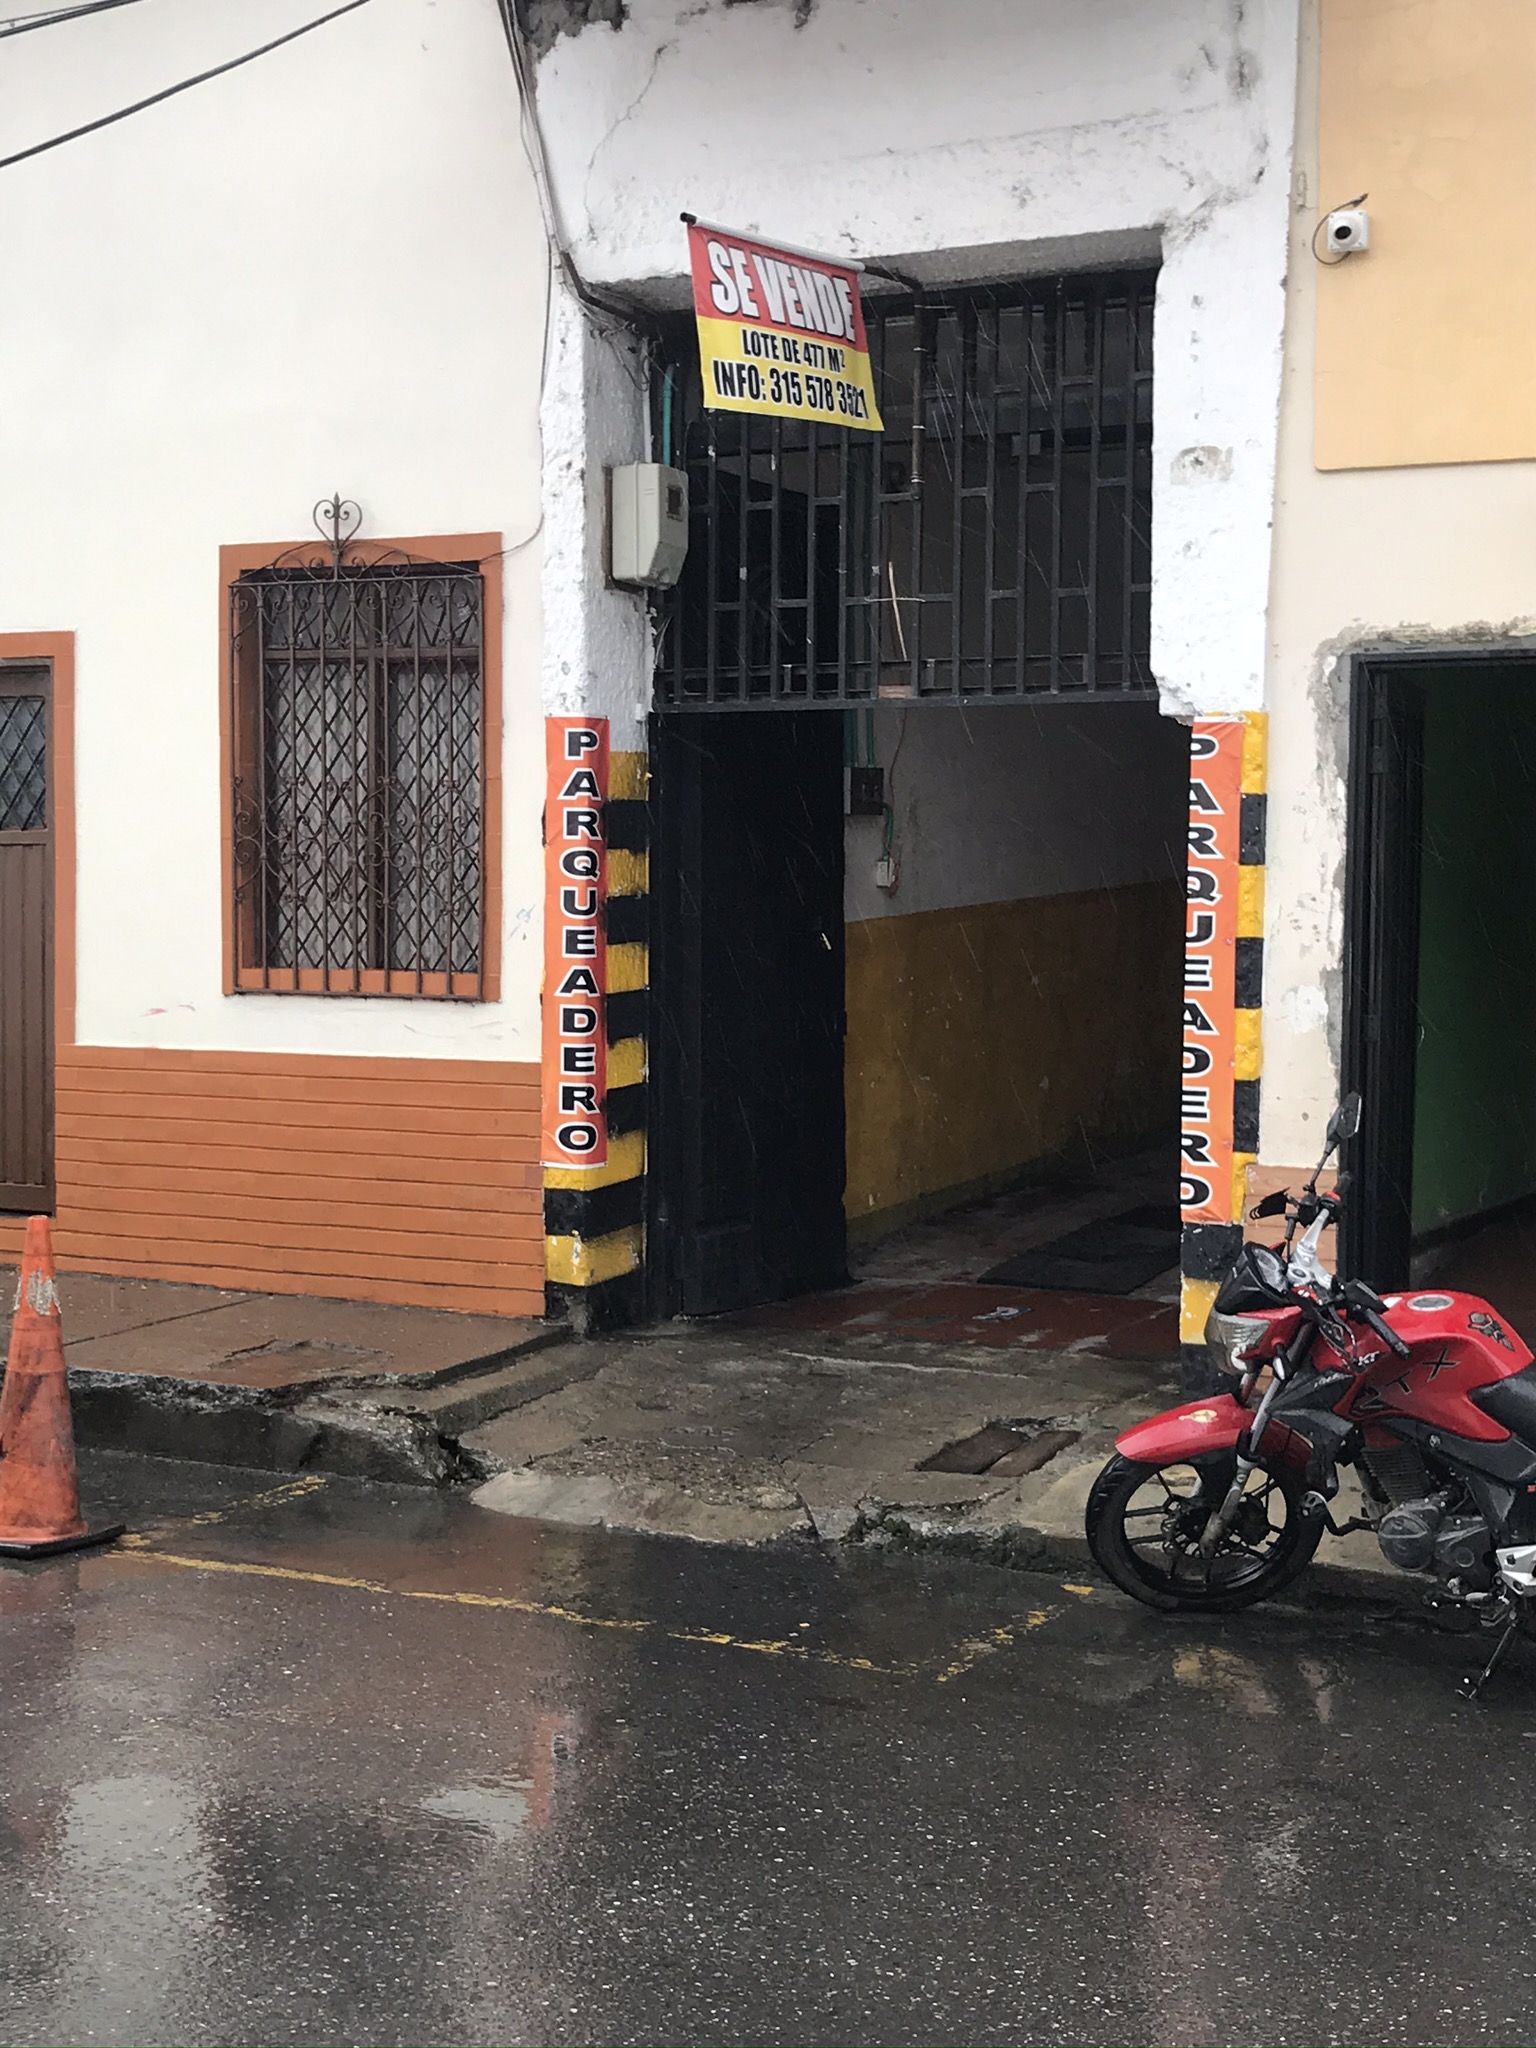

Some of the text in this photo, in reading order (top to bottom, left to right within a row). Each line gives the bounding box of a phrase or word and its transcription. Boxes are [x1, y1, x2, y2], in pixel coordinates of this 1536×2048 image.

[706, 239, 857, 343] SE VENDE
[713, 360, 869, 419] INFO: 315 578 3521
[742, 329, 779, 360] LOTE
[781, 337, 800, 364] DE
[804, 342, 825, 369] 477
[555, 728, 601, 1154] PARQUEADERO
